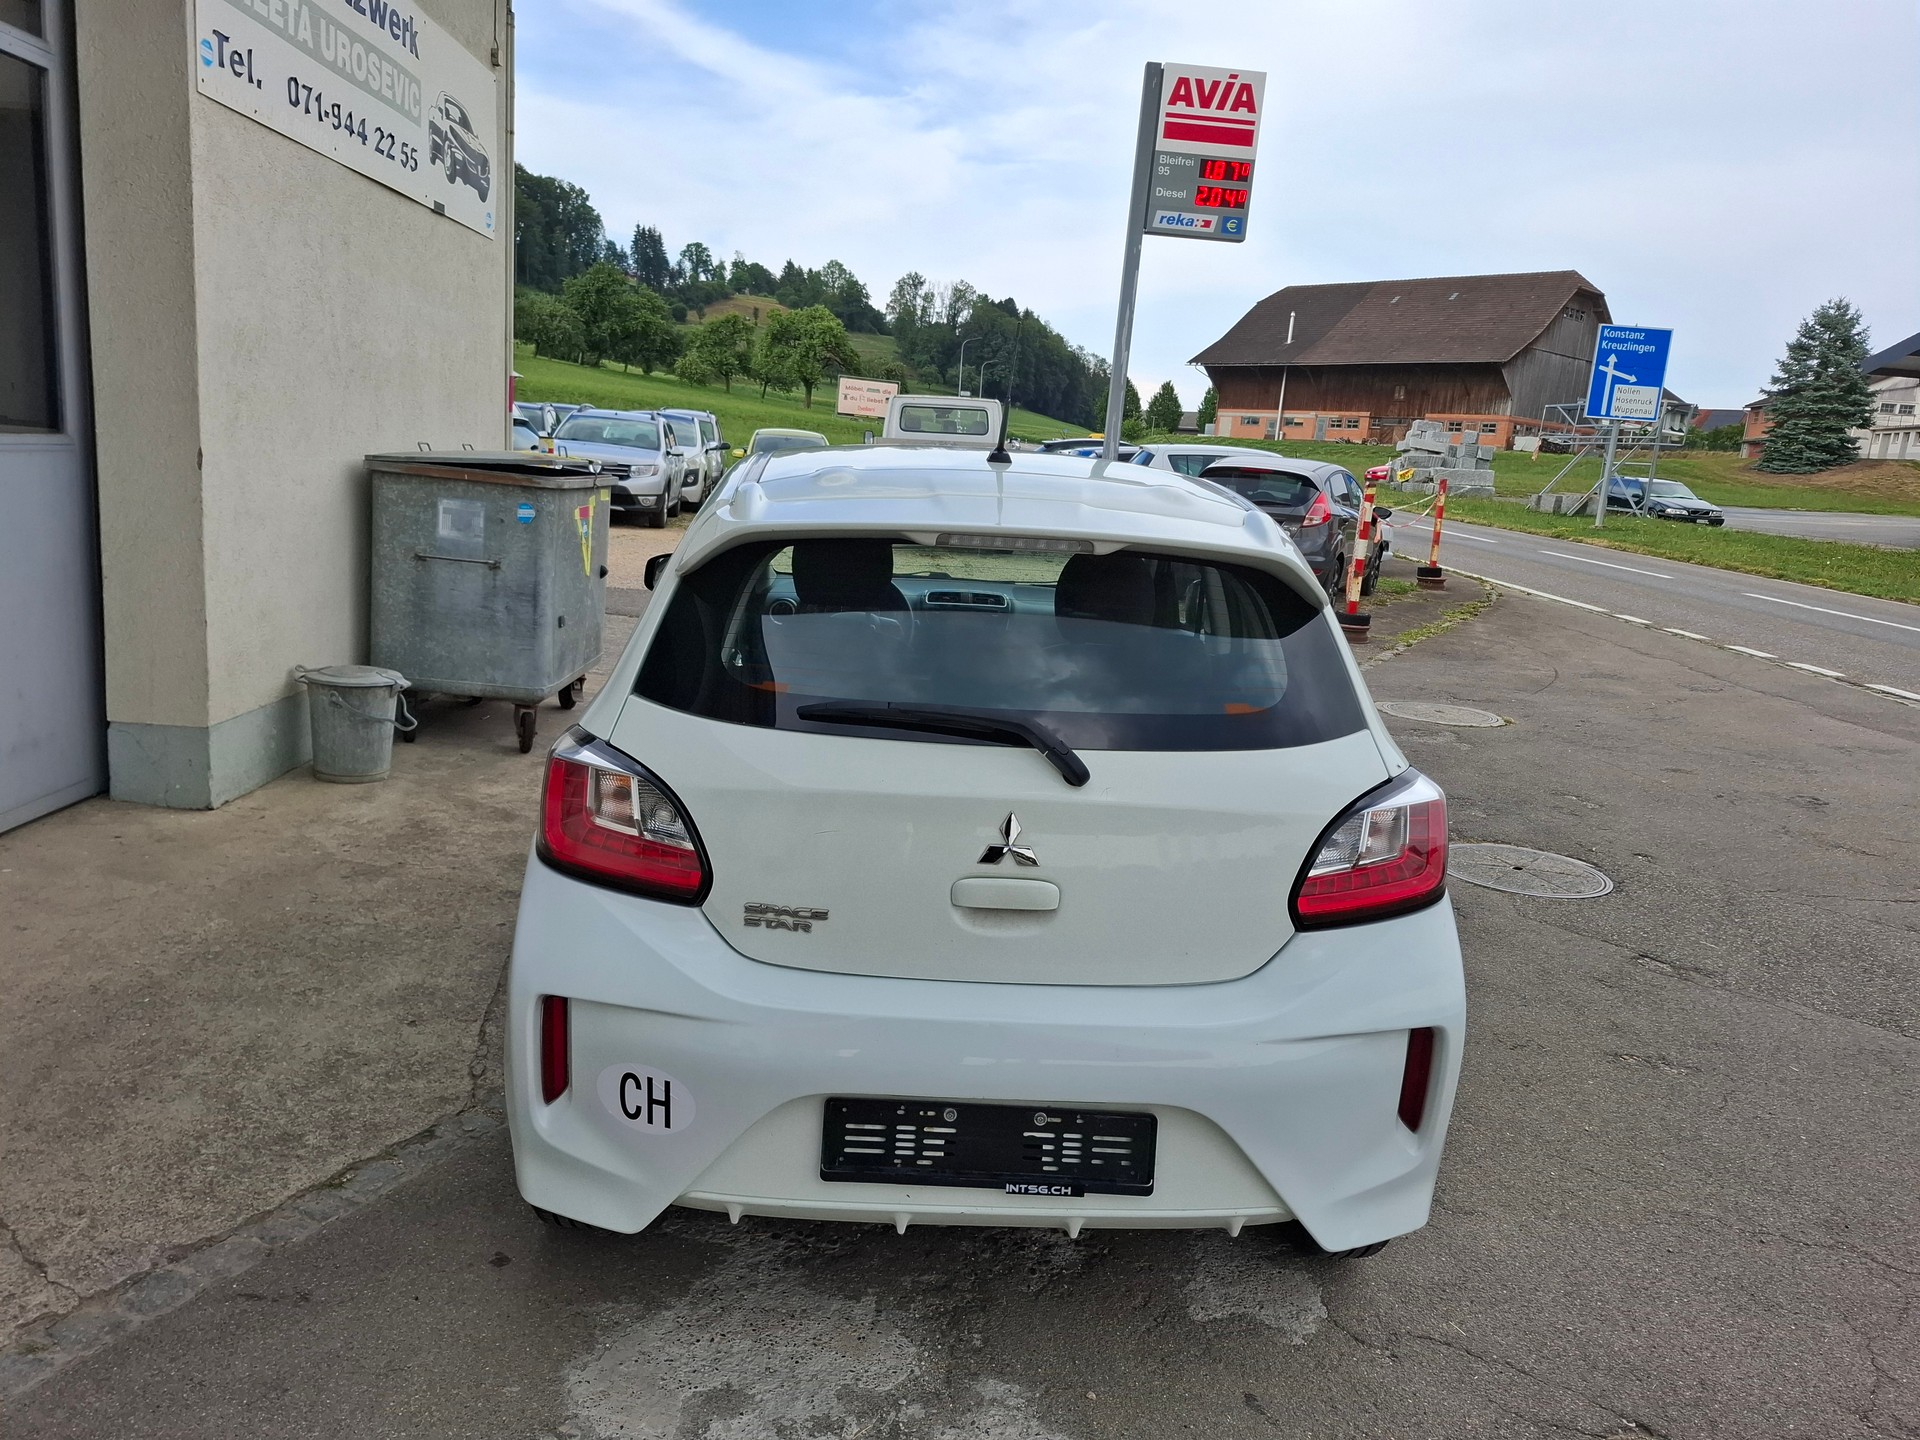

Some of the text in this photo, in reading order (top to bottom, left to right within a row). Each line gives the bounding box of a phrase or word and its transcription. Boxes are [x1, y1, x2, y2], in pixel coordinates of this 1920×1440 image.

[344, 0, 421, 61] werk
[319, 17, 421, 118] UROSEVIC
[212, 29, 418, 172] Tel. 071-944 22 55
[1159, 155, 1195, 167] Bleifrei
[1158, 166, 1170, 176] 95
[1155, 188, 1187, 199] Diesel
[1603, 328, 1645, 340] Konstanz
[1601, 340, 1656, 354] Kreuzlingen
[1616, 387, 1641, 395] Nollen
[1615, 396, 1653, 406] Hosenruck
[1614, 405, 1653, 415] Wuppenau
[744, 902, 829, 921] SPACE
[744, 915, 812, 933] STAR
[620, 1072, 671, 1129] CH
[1005, 1183, 1072, 1195] INTSG.CH
